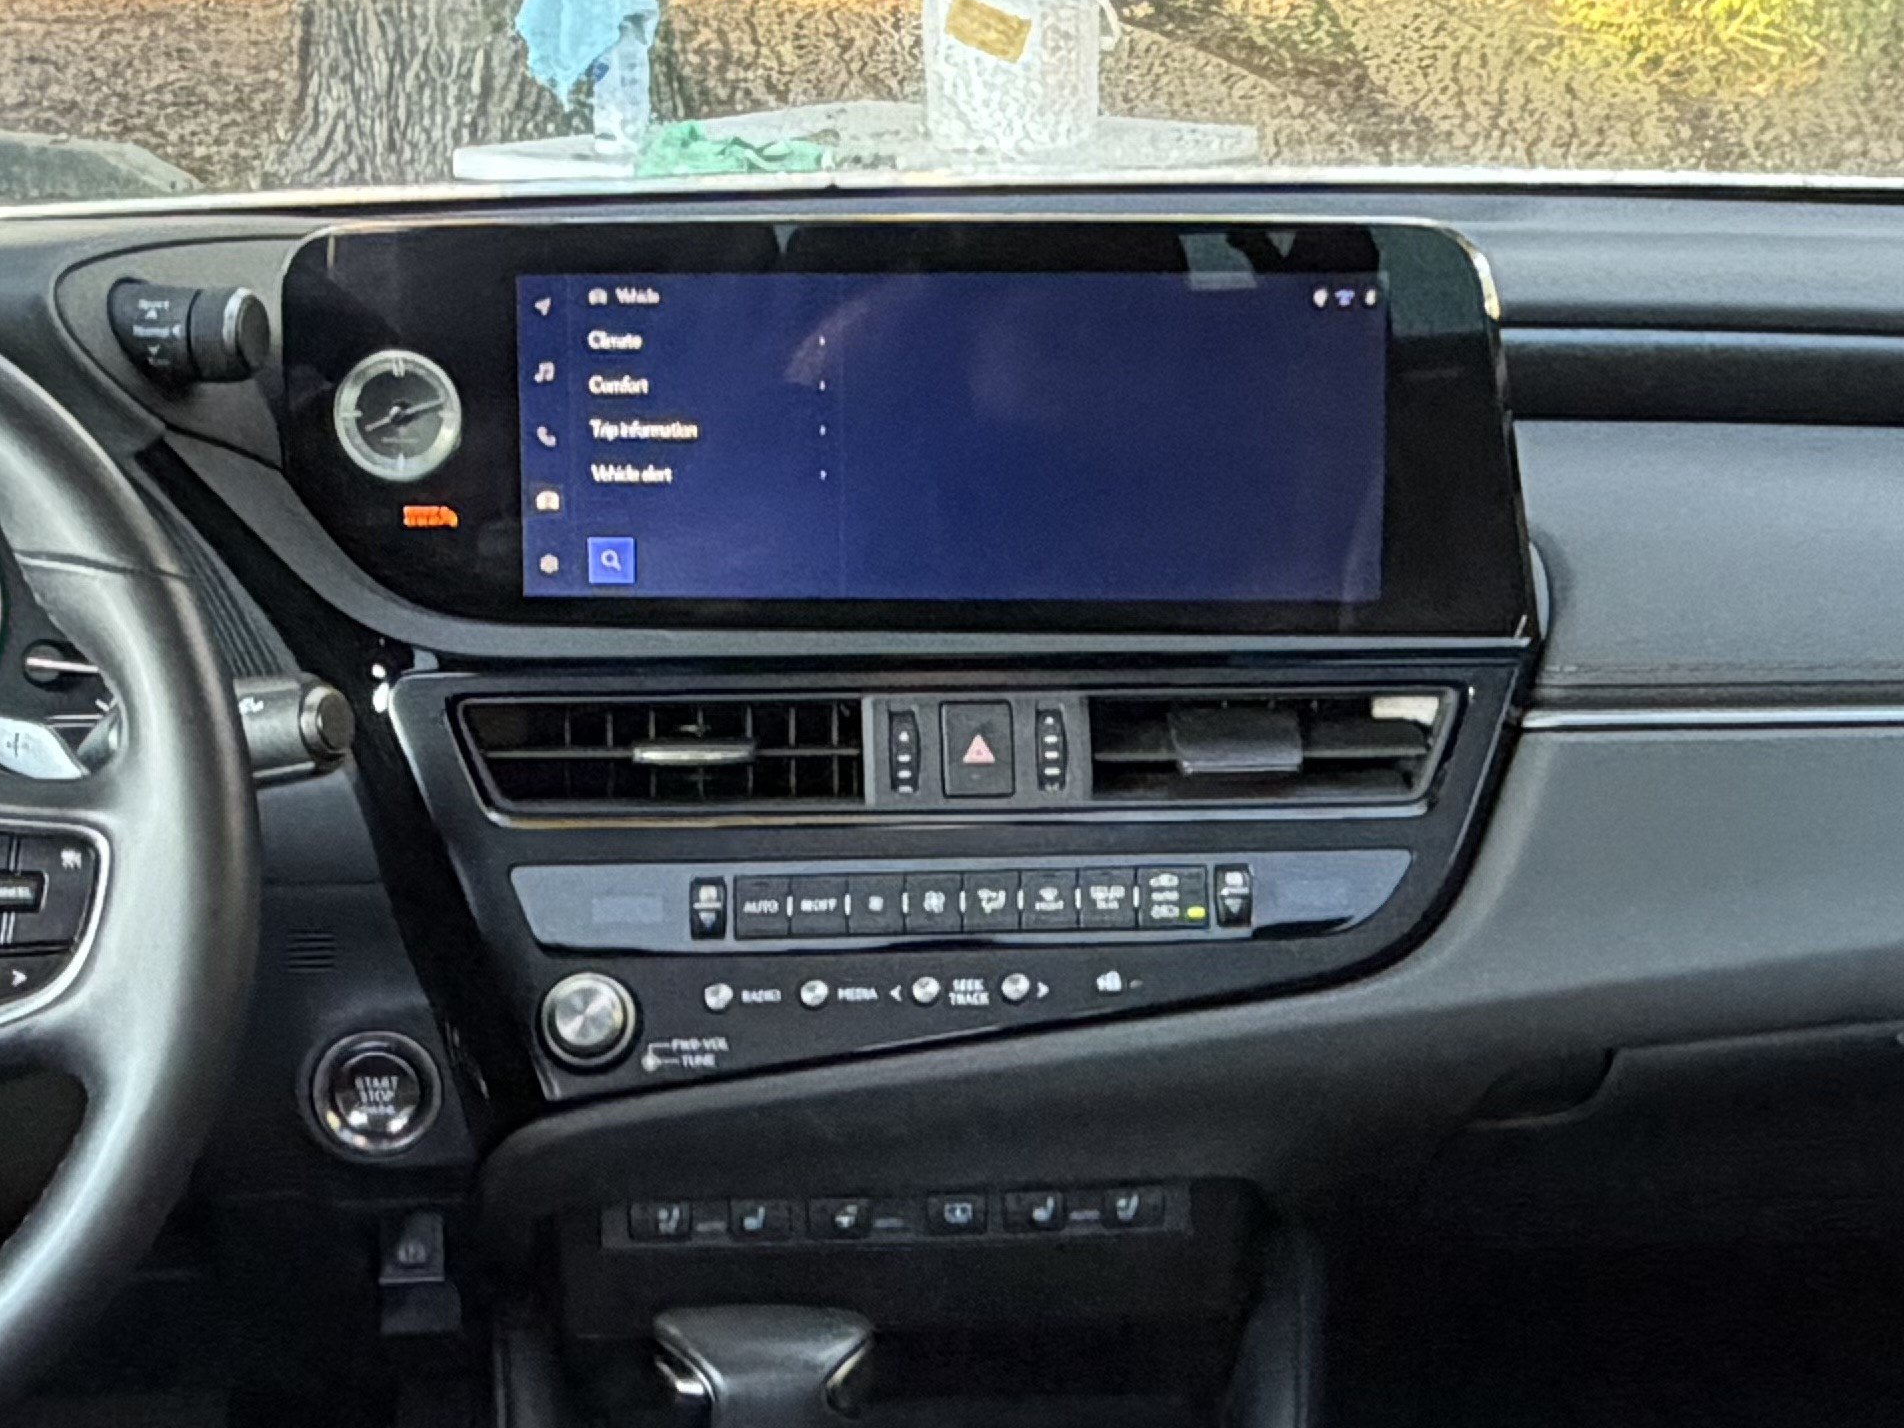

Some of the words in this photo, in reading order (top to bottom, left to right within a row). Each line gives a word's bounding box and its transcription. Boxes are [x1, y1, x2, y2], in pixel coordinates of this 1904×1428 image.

[615, 287, 661, 305] Vehicle
[586, 330, 643, 351] Climate
[587, 374, 650, 395] Comfort
[589, 419, 620, 441] Trip
[621, 419, 699, 439] information
[590, 464, 640, 483] Vehicle
[641, 464, 673, 483] alert
[742, 898, 780, 914] AUTO
[952, 977, 985, 992] SEEK
[740, 988, 782, 1004] RADIO
[836, 985, 879, 1001] MEDIA
[948, 991, 990, 1007] TRACK
[680, 1053, 717, 1069] TUNE
[353, 1075, 400, 1091] START
[358, 1090, 395, 1103] STOP
